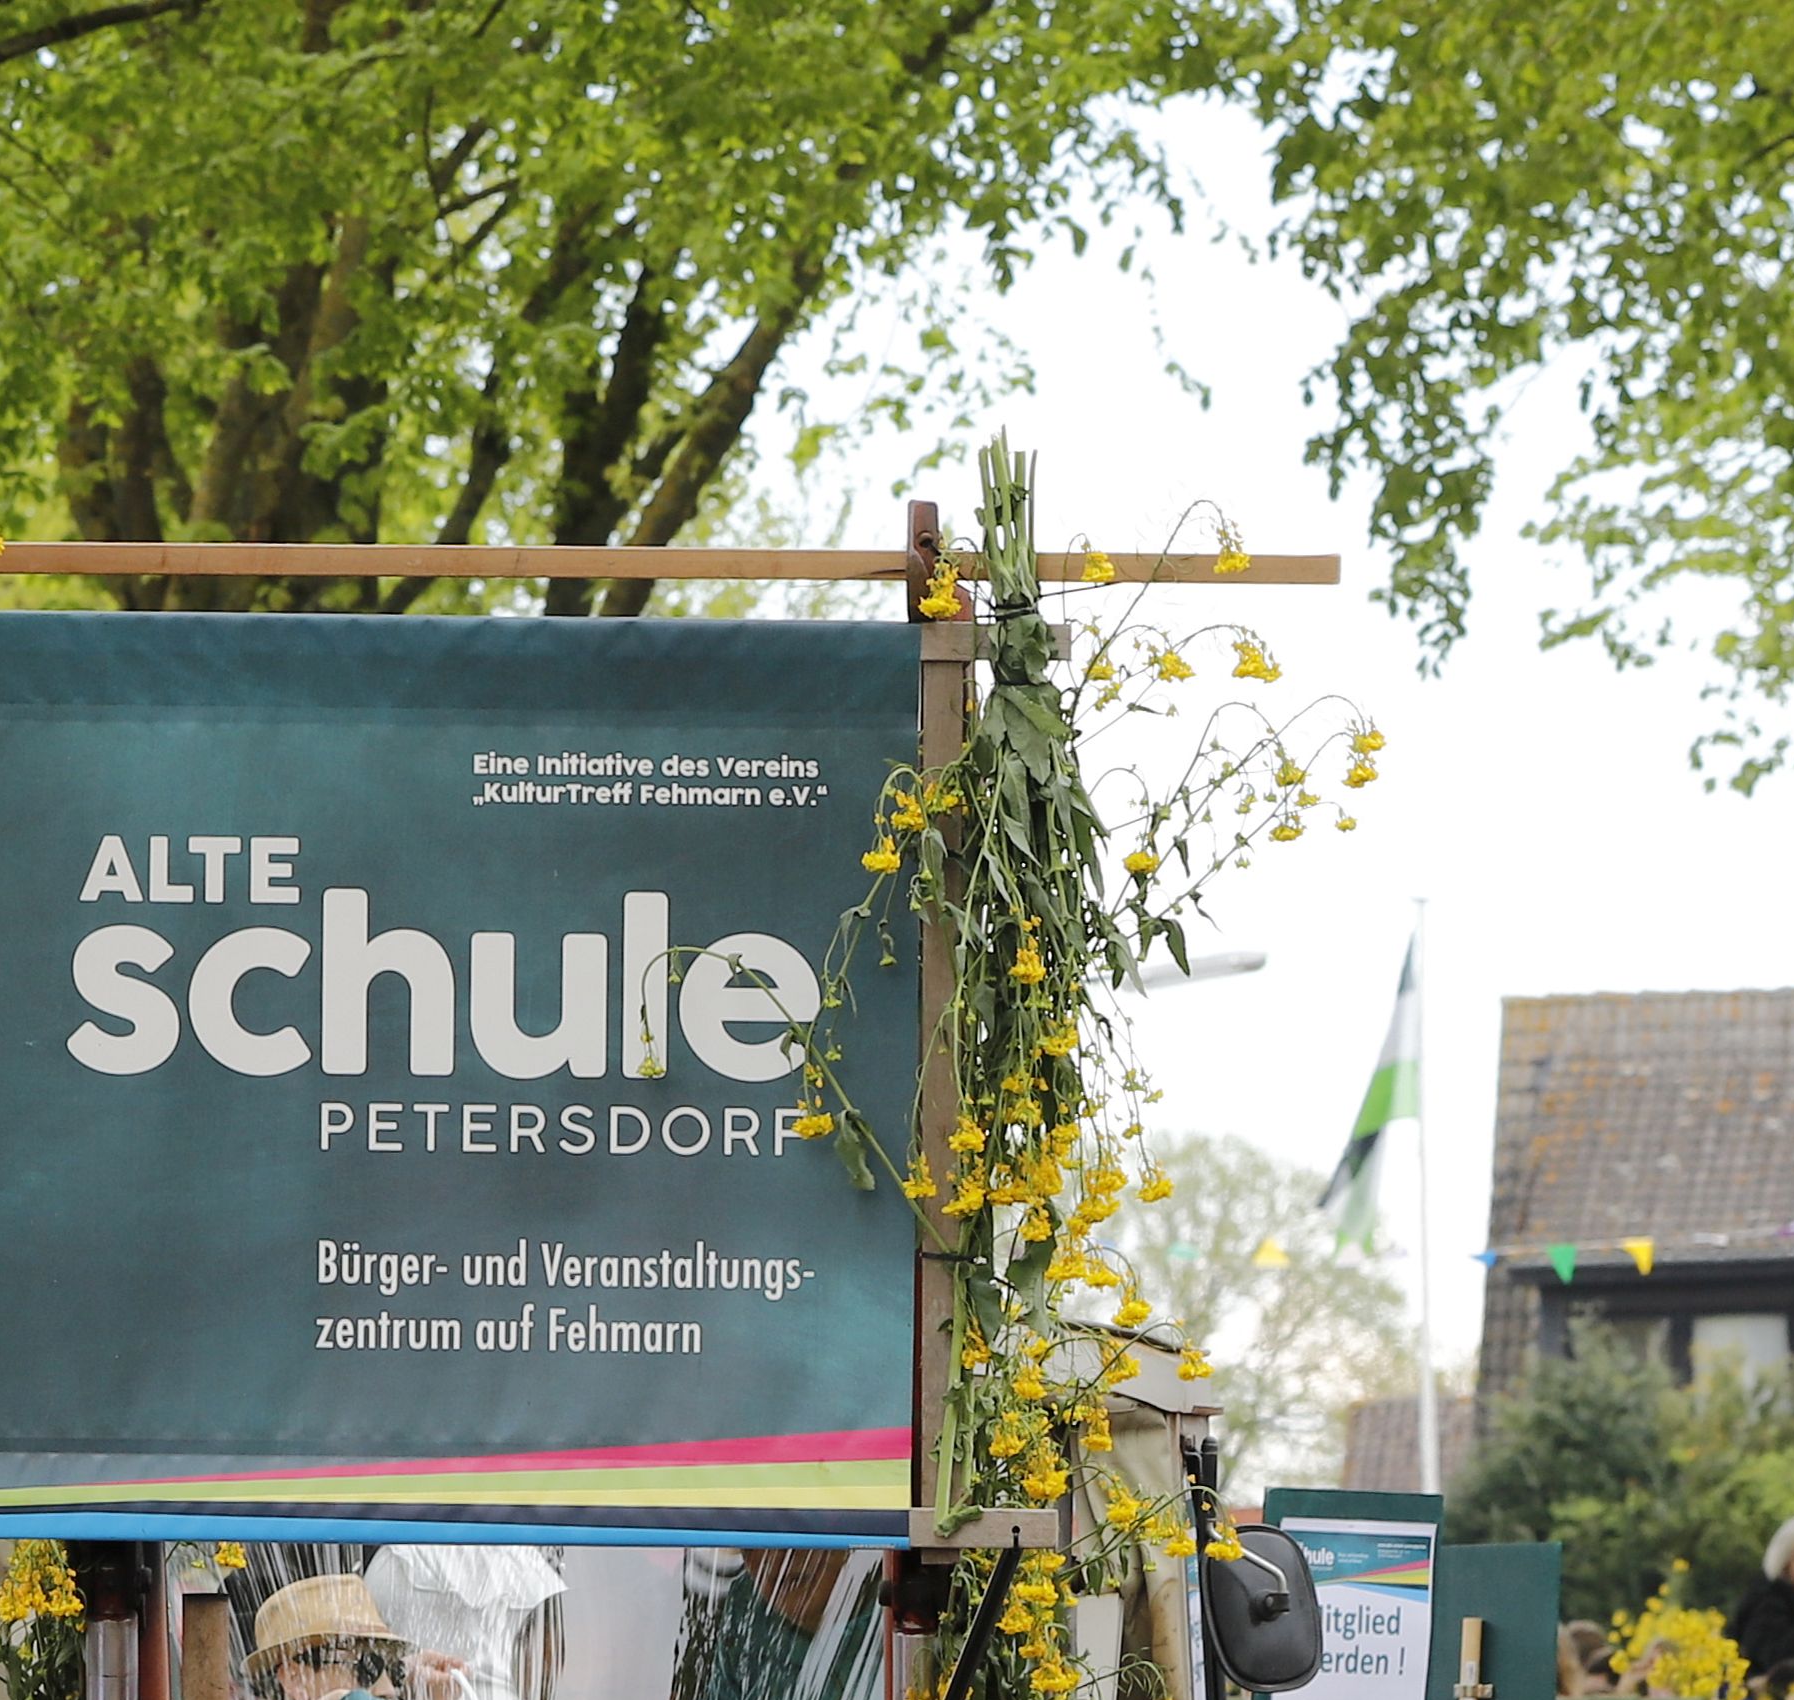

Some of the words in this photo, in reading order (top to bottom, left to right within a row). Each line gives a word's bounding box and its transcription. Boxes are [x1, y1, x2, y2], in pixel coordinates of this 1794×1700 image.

[472, 751, 530, 775] Eine
[537, 752, 654, 776] Initiative
[661, 754, 709, 777] des
[716, 755, 820, 779] Vereins
[472, 781, 633, 806] „KulturTreff
[640, 783, 761, 806] Fehmarn
[768, 785, 829, 806] e.V.“
[79, 835, 300, 904] ALTE
[67, 887, 821, 1082] schule
[319, 1101, 809, 1157] PETERSDORF
[317, 1238, 448, 1296] Bürger-
[462, 1237, 528, 1287] und
[541, 1240, 815, 1300] Veranstaltungs-
[315, 1311, 461, 1351] zentrum
[475, 1303, 535, 1352] auf
[547, 1304, 703, 1354] Fehmarn
[1319, 1604, 1401, 1640] itglied
[1320, 1646, 1388, 1675] erden
